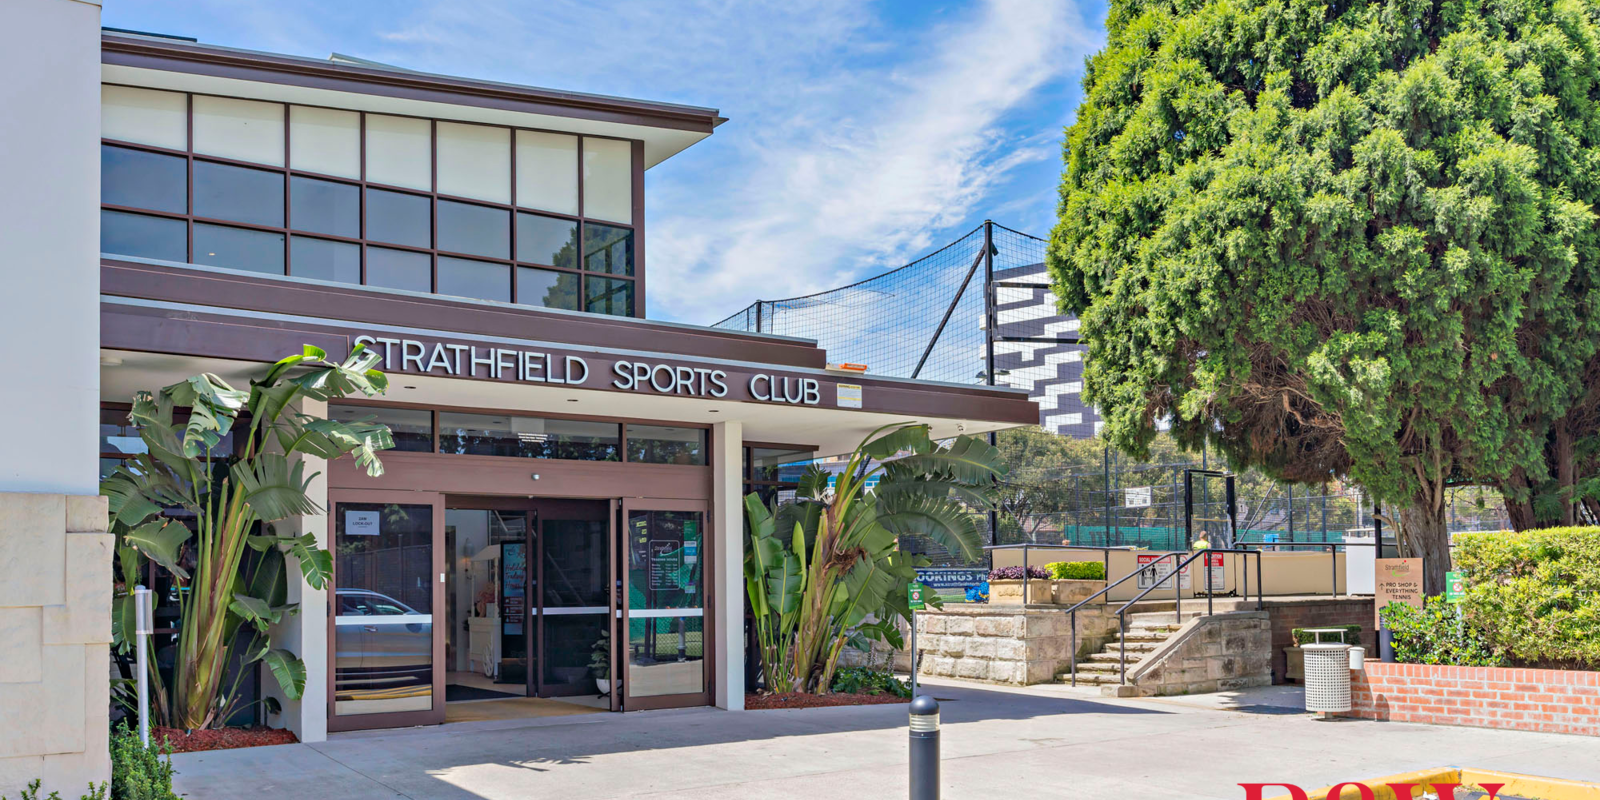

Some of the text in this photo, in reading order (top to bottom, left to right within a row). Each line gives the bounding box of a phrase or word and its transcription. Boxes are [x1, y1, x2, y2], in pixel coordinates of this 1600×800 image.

[353, 335, 589, 385] STRATHFIELD
[612, 360, 728, 398] SPORTS
[749, 373, 821, 405] CLUB
[917, 571, 973, 582] OOKINGS
